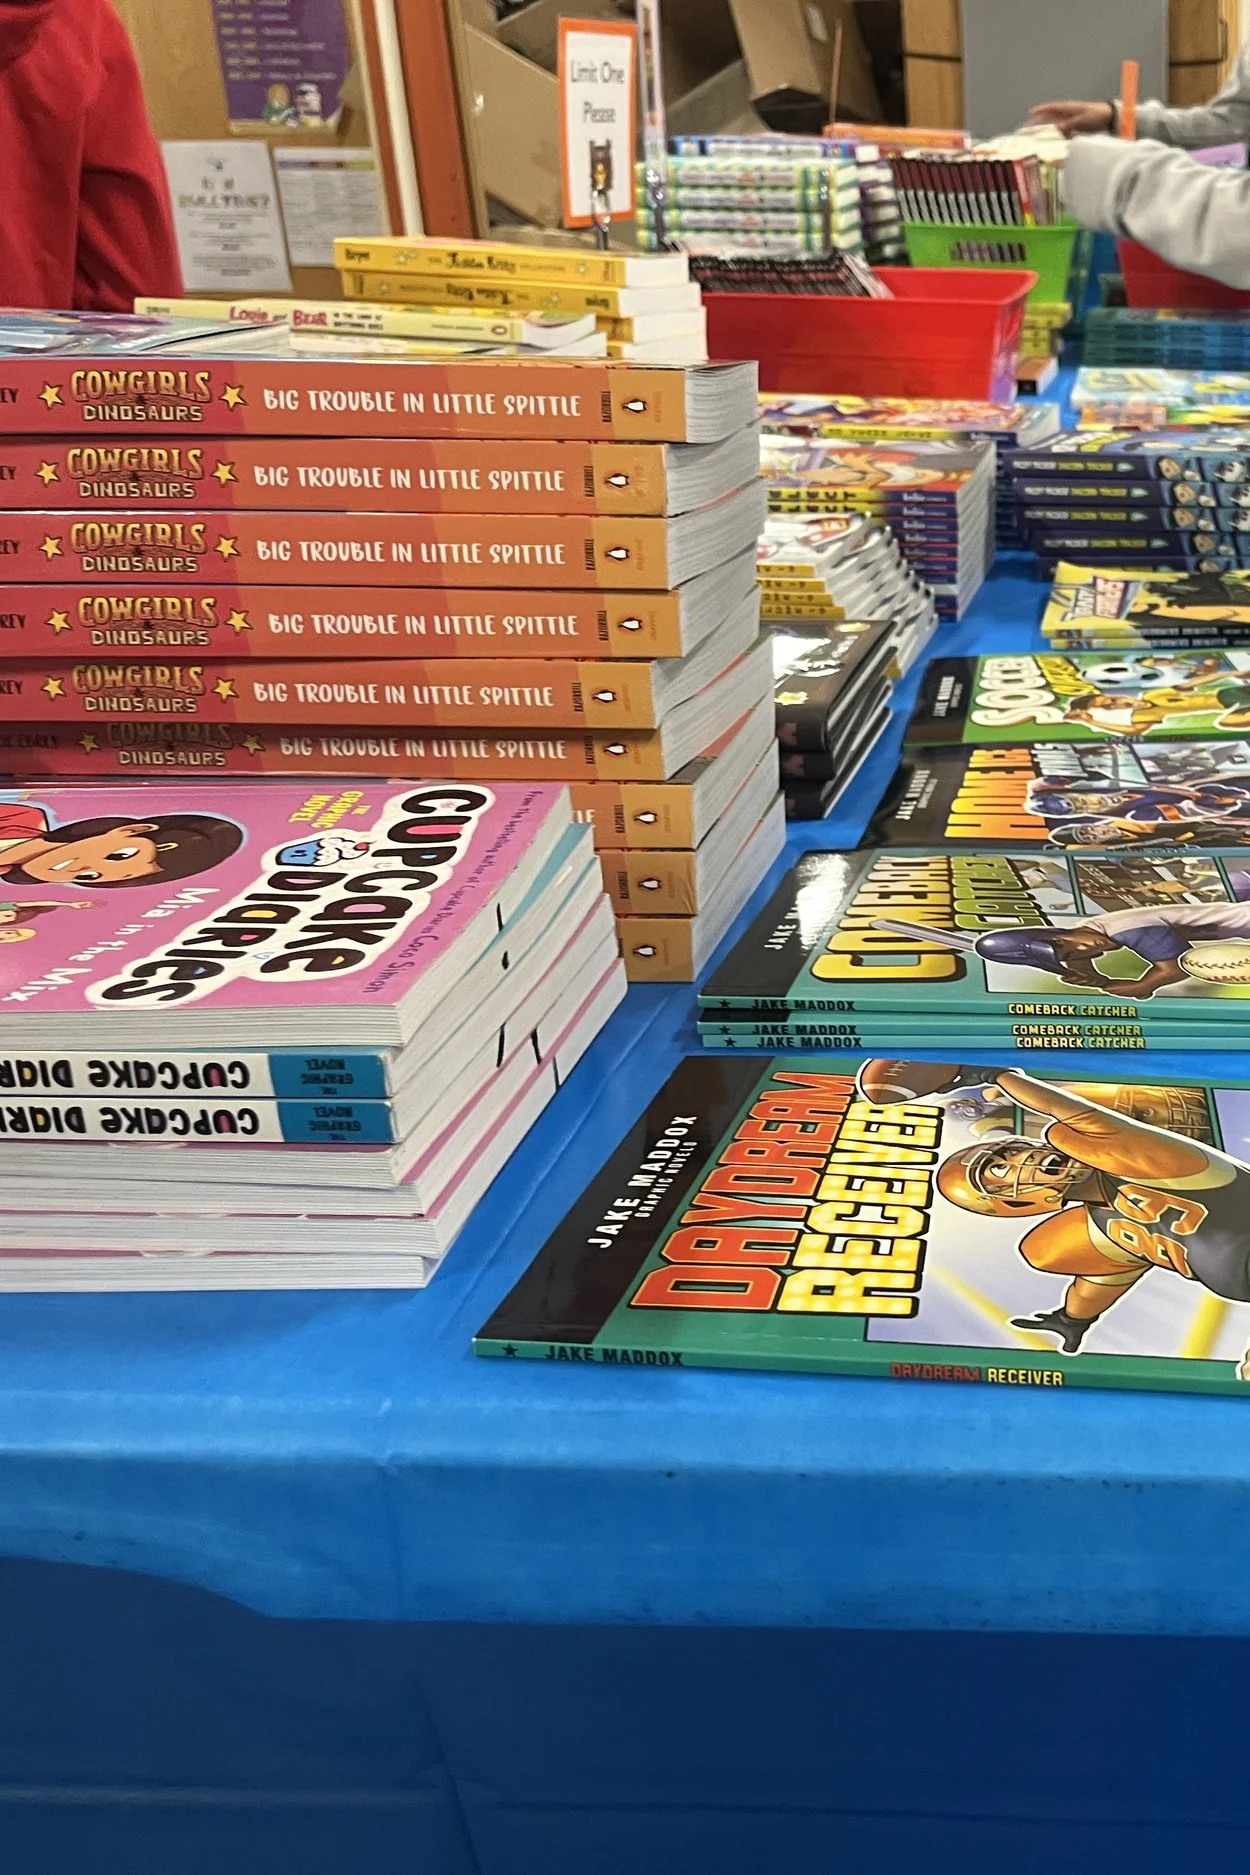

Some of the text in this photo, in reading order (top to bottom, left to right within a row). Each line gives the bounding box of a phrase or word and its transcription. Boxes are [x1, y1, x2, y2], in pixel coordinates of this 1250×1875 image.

[602, 62, 625, 83] One
[70, 370, 211, 402] COWGIRLS
[83, 405, 203, 421] DINOSAURS
[264, 389, 581, 417] BIG TROUBLE IN LITTLE SPITTLE
[67, 448, 203, 480] COWGIRLS
[79, 482, 195, 498] DINOSAURS
[254, 466, 565, 491] BIG TROUBLE IN LITTLE SPITTLE
[70, 523, 207, 554] COWGIRLS
[82, 557, 198, 572] DINOSAURS
[257, 540, 565, 565] BIG TROUBLE IN LITTLE SPITTLE
[77, 597, 218, 628] COWGIRLS
[268, 613, 578, 636] BIG TROUBLE IN LITTLE SPITTLE
[90, 630, 210, 645] DINOSAURS
[72, 665, 207, 696] COWGIRLS
[84, 697, 197, 713] DINOSAURS
[253, 683, 555, 707] BIG TROUBLE IN LITTLE SPITTLE
[106, 722, 235, 749] COWGIRLS
[279, 736, 567, 759] BIG TROUBLE IN LITTLE SPITTLE
[118, 750, 226, 766] DINOSAURS
[287, 794, 335, 821] NOVEL
[310, 791, 364, 828] GRAPHIC
[944, 771, 1051, 840] HOME
[811, 855, 960, 982] COMEBACK
[1, 887, 220, 1002] Mia in the Mix
[764, 916, 797, 950] JAKE
[363, 934, 439, 993] Coco Simon
[751, 999, 856, 1011] JAKE MADDOX
[1008, 1004, 1137, 1017] COMEBACK CATCHER
[752, 1024, 857, 1036] JAKE MADDOX
[757, 1036, 861, 1048] JAKE MADDOX
[1012, 1025, 1142, 1036] COMEBACK CATCHER
[1017, 1038, 1146, 1048] COMEBACK CATCHER
[587, 1115, 697, 1248] JAKE MADDOX
[629, 1072, 858, 1311] DAYDREAM
[776, 1100, 944, 1317] RECEIVER
[1106, 1183, 1209, 1278] 89
[545, 1344, 683, 1366] JAKE MADDOX
[891, 1363, 1063, 1386] DAYDREAM RECEIVER
